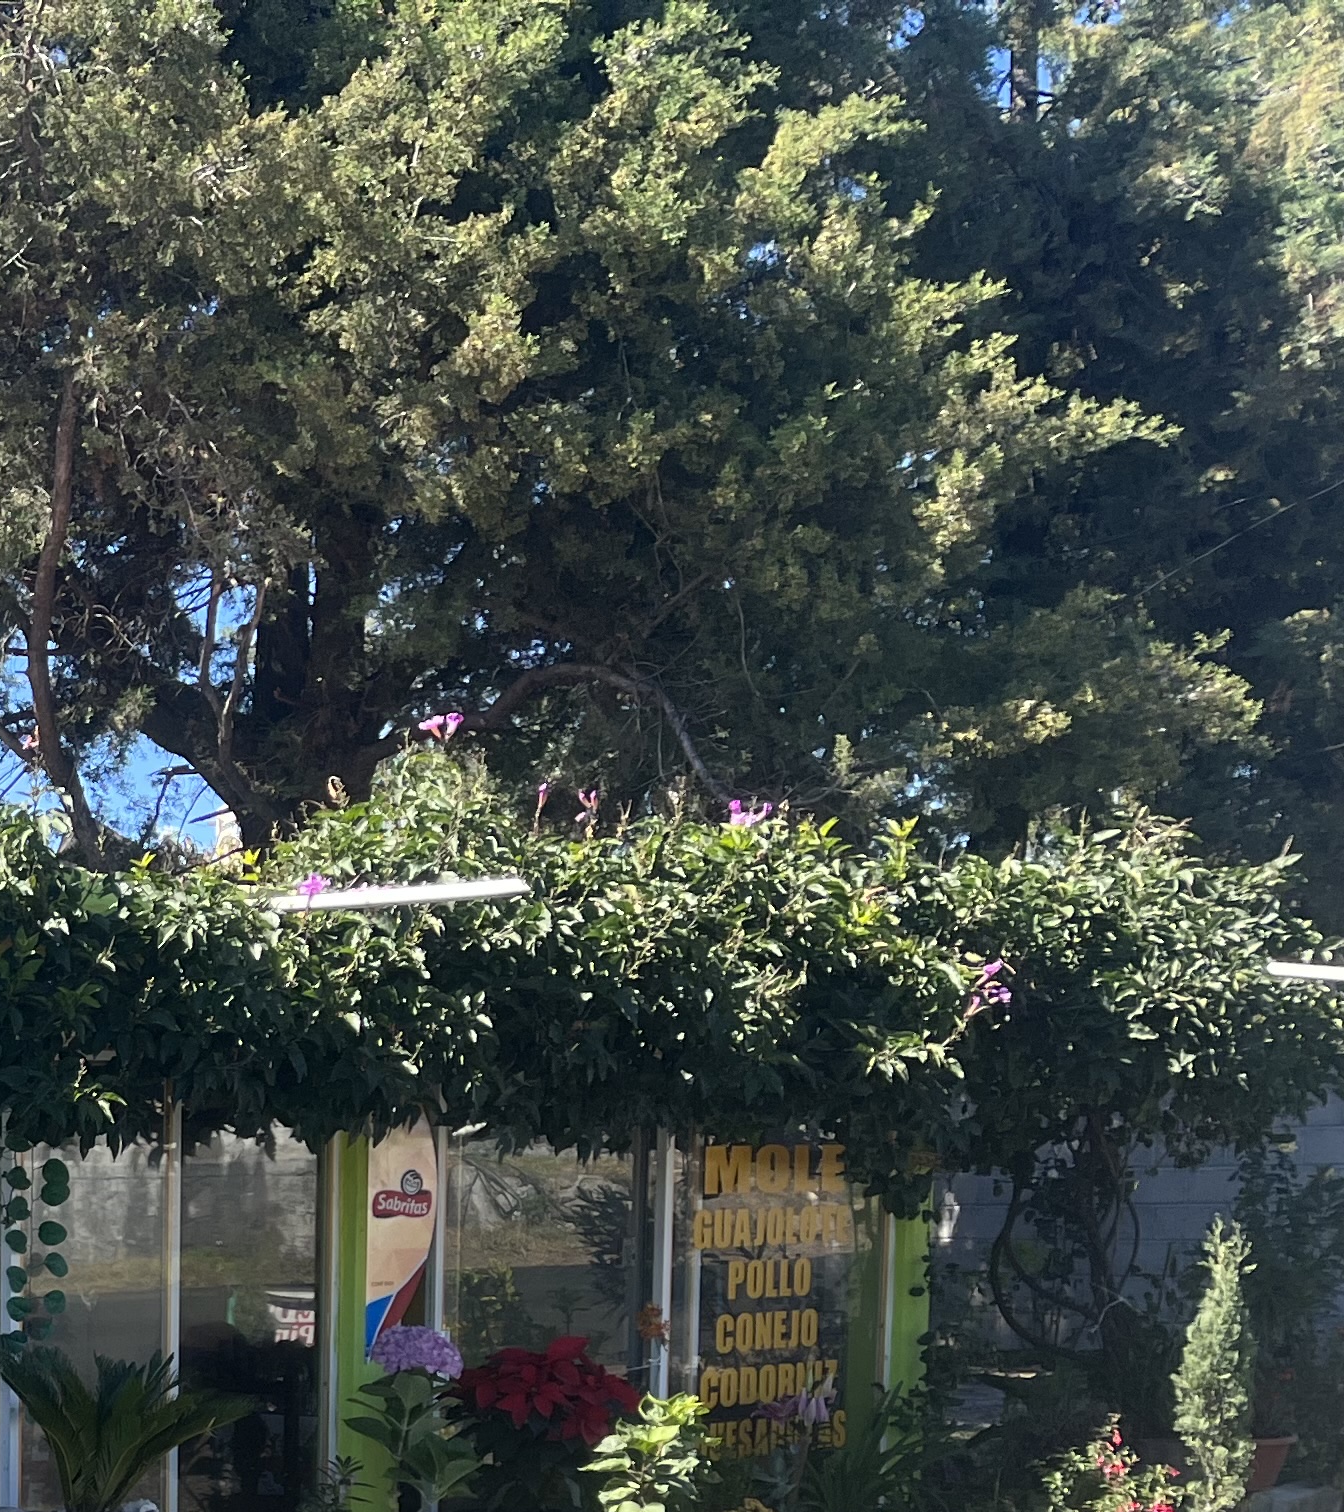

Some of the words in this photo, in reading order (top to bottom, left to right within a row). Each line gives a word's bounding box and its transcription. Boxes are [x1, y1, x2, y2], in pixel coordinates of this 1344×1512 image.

[704, 1143, 847, 1196] MOLE
[377, 1193, 428, 1214] Sabritas
[693, 1204, 851, 1250] GUAJOLOTE
[727, 1258, 812, 1300] POLLO
[715, 1308, 819, 1354] CONEJO
